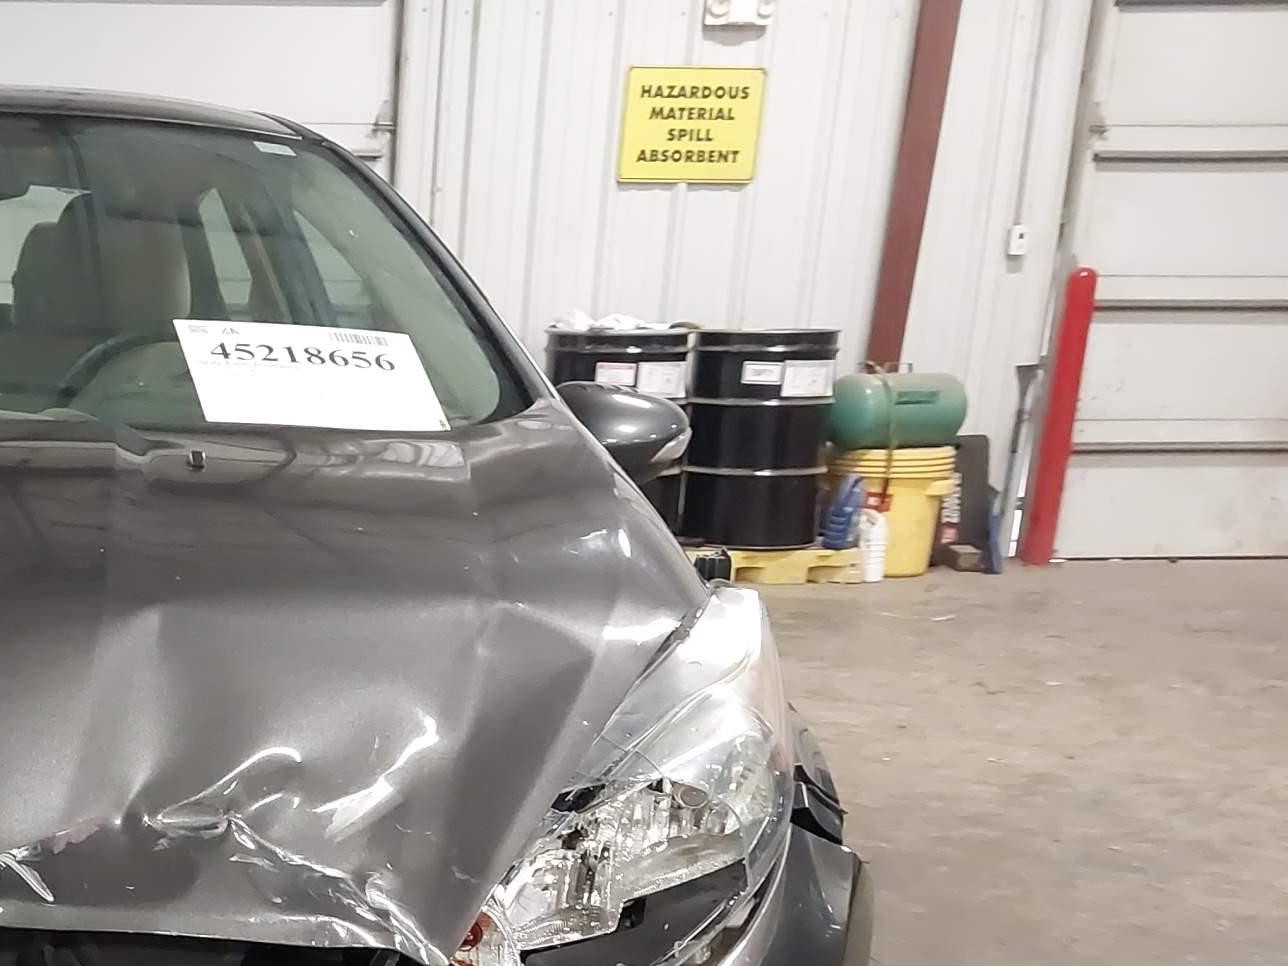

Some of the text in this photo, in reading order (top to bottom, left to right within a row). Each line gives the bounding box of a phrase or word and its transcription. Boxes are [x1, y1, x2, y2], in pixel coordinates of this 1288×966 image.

[640, 85, 750, 99] HAZARDOUS
[649, 107, 735, 120] MATERIAL
[667, 128, 714, 141] SPILL
[636, 149, 740, 163] ABSORBENT
[210, 342, 396, 372] 45218656
